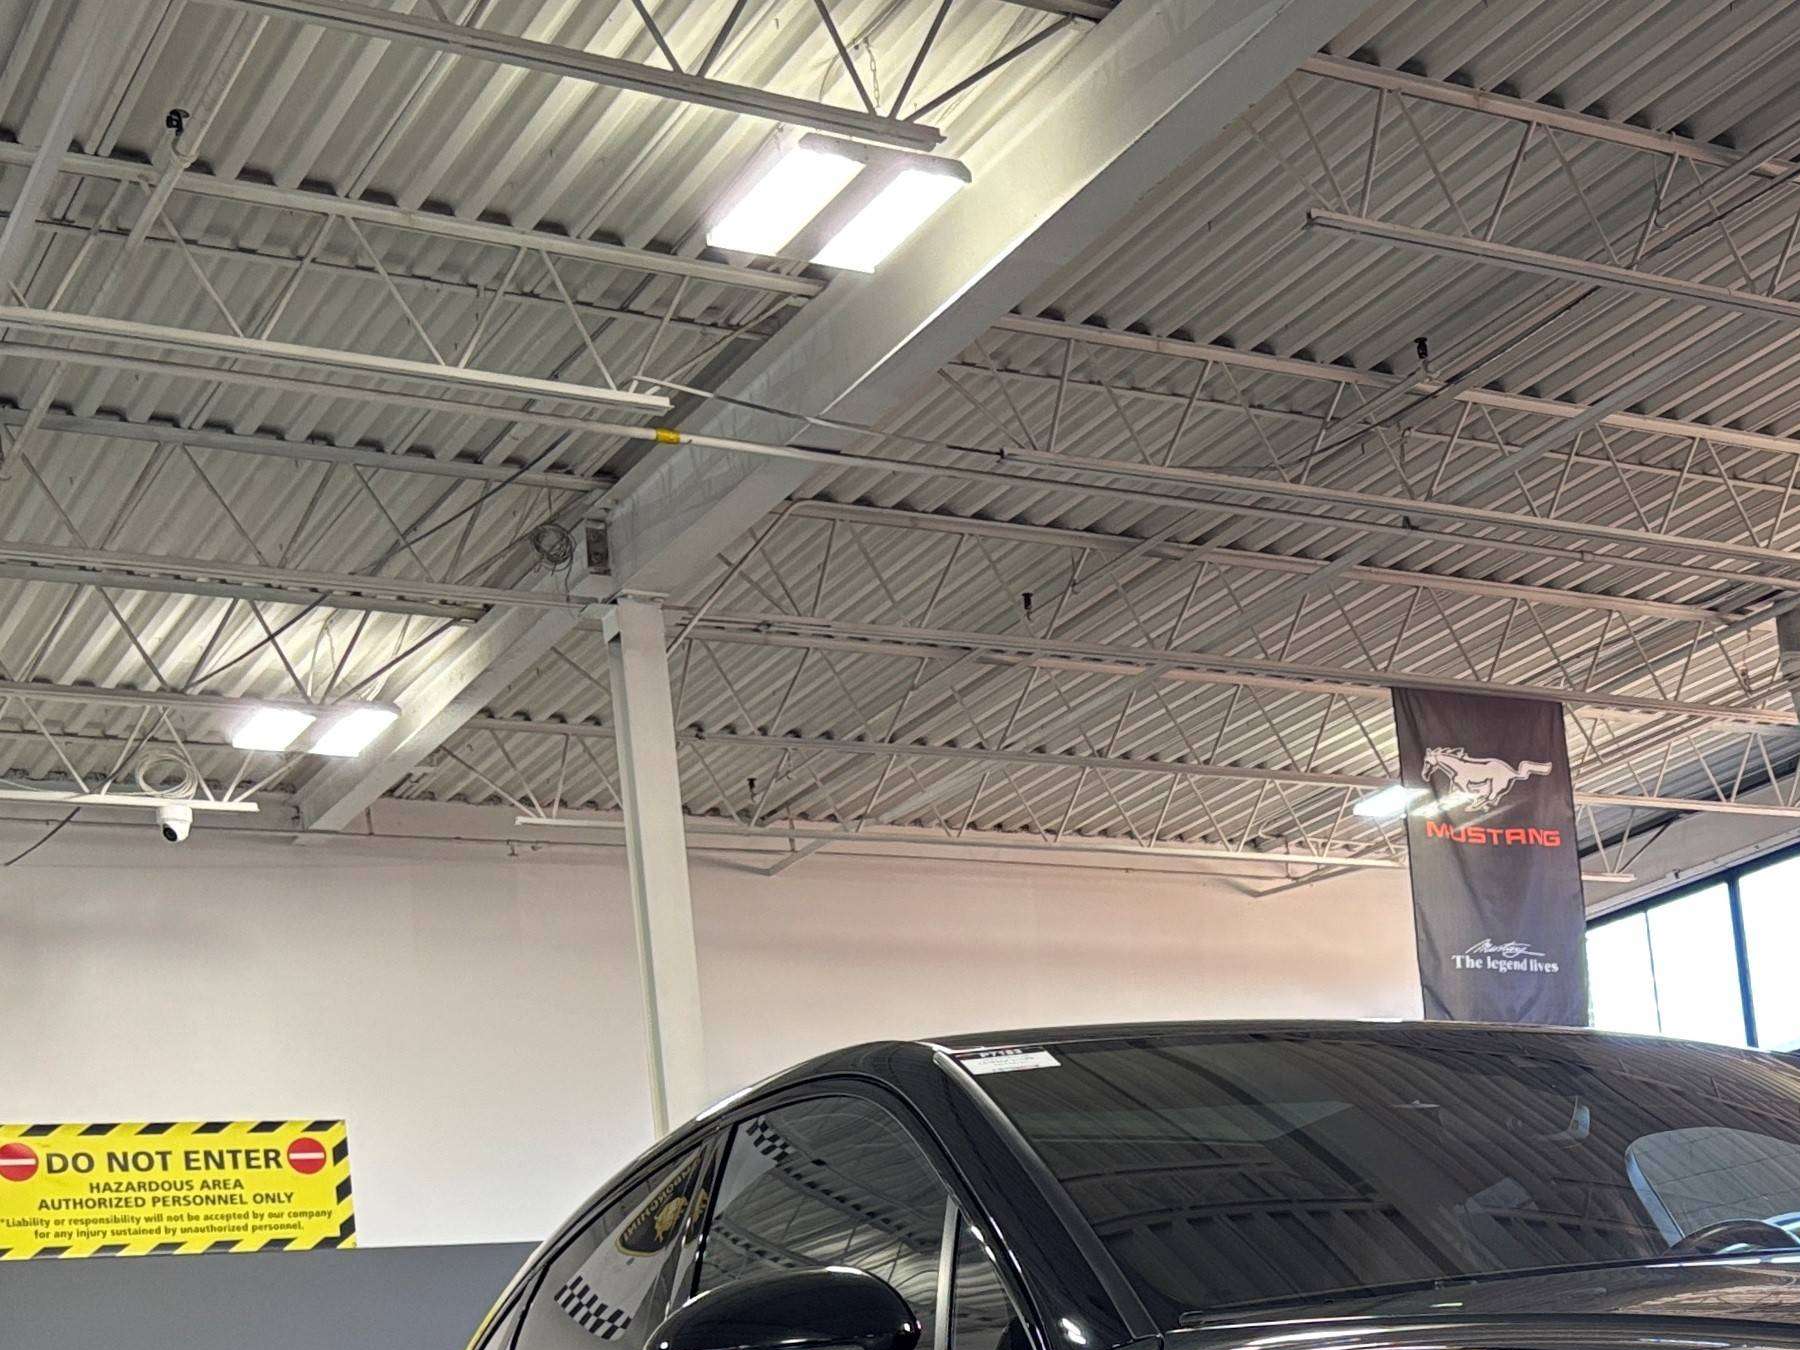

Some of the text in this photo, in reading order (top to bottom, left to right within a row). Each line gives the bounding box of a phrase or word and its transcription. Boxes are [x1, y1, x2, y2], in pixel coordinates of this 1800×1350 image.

[1426, 820, 1561, 847] MUSTANG
[1451, 954, 1559, 973] The legend lives
[46, 1148, 283, 1174] DO NOT ENTER
[89, 1178, 245, 1194] HAZARDOUS AREA
[38, 1191, 295, 1211] AUTHORIZED PERSONNEL ONLY
[54, 1219, 66, 1227] or
[68, 1214, 141, 1227] responsibility
[144, 1213, 164, 1223] will
[166, 1213, 184, 1222] not
[187, 1212, 200, 1221] be
[203, 1211, 250, 1223] accepted
[252, 1211, 265, 1220] by
[287, 1210, 333, 1219] company
[34, 1230, 50, 1239] for
[54, 1231, 73, 1240] any
[76, 1229, 108, 1240] injury
[110, 1226, 161, 1237] sustained
[164, 1226, 177, 1236] by
[180, 1222, 248, 1234] unauthorized
